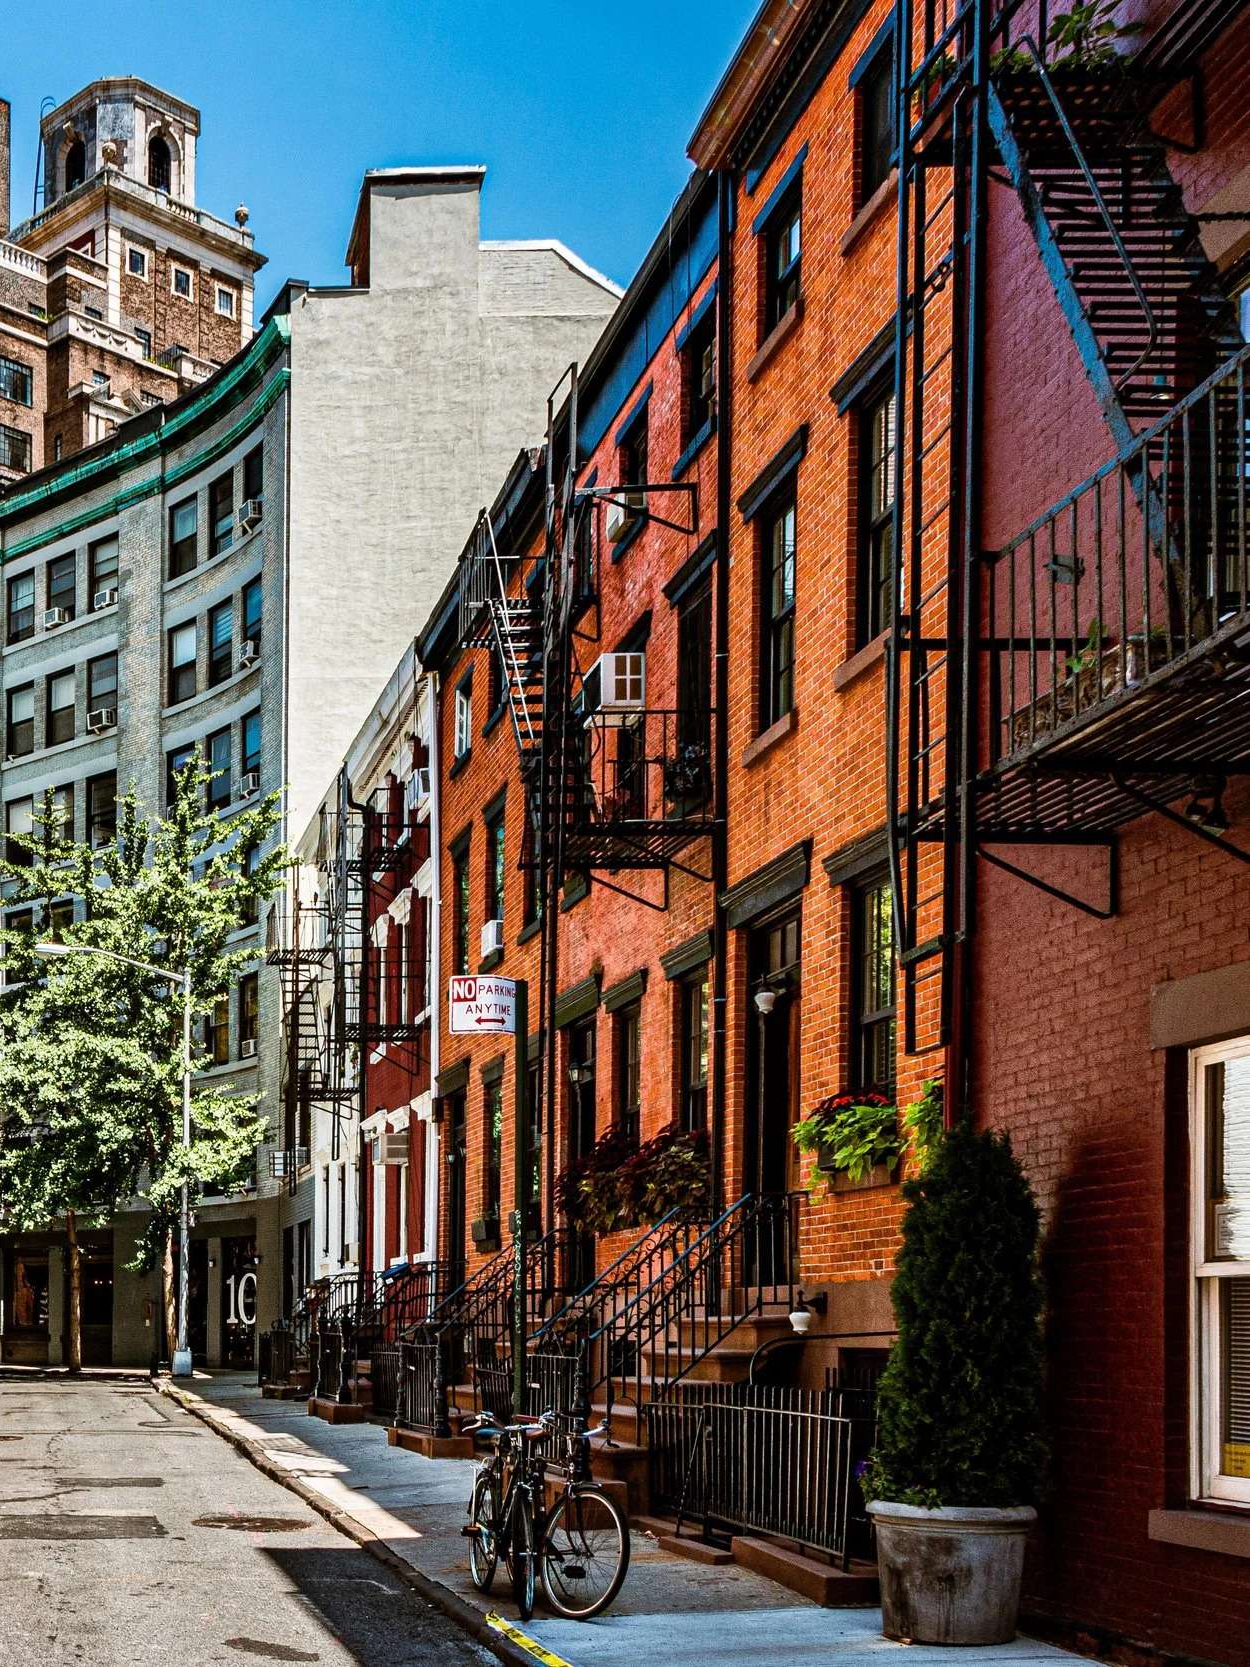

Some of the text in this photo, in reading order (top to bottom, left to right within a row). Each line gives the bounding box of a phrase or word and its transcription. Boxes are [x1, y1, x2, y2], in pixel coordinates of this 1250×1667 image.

[453, 980, 517, 1000] NO PARKING
[465, 1003, 511, 1016] ANYTIME
[226, 1272, 257, 1325] 10
